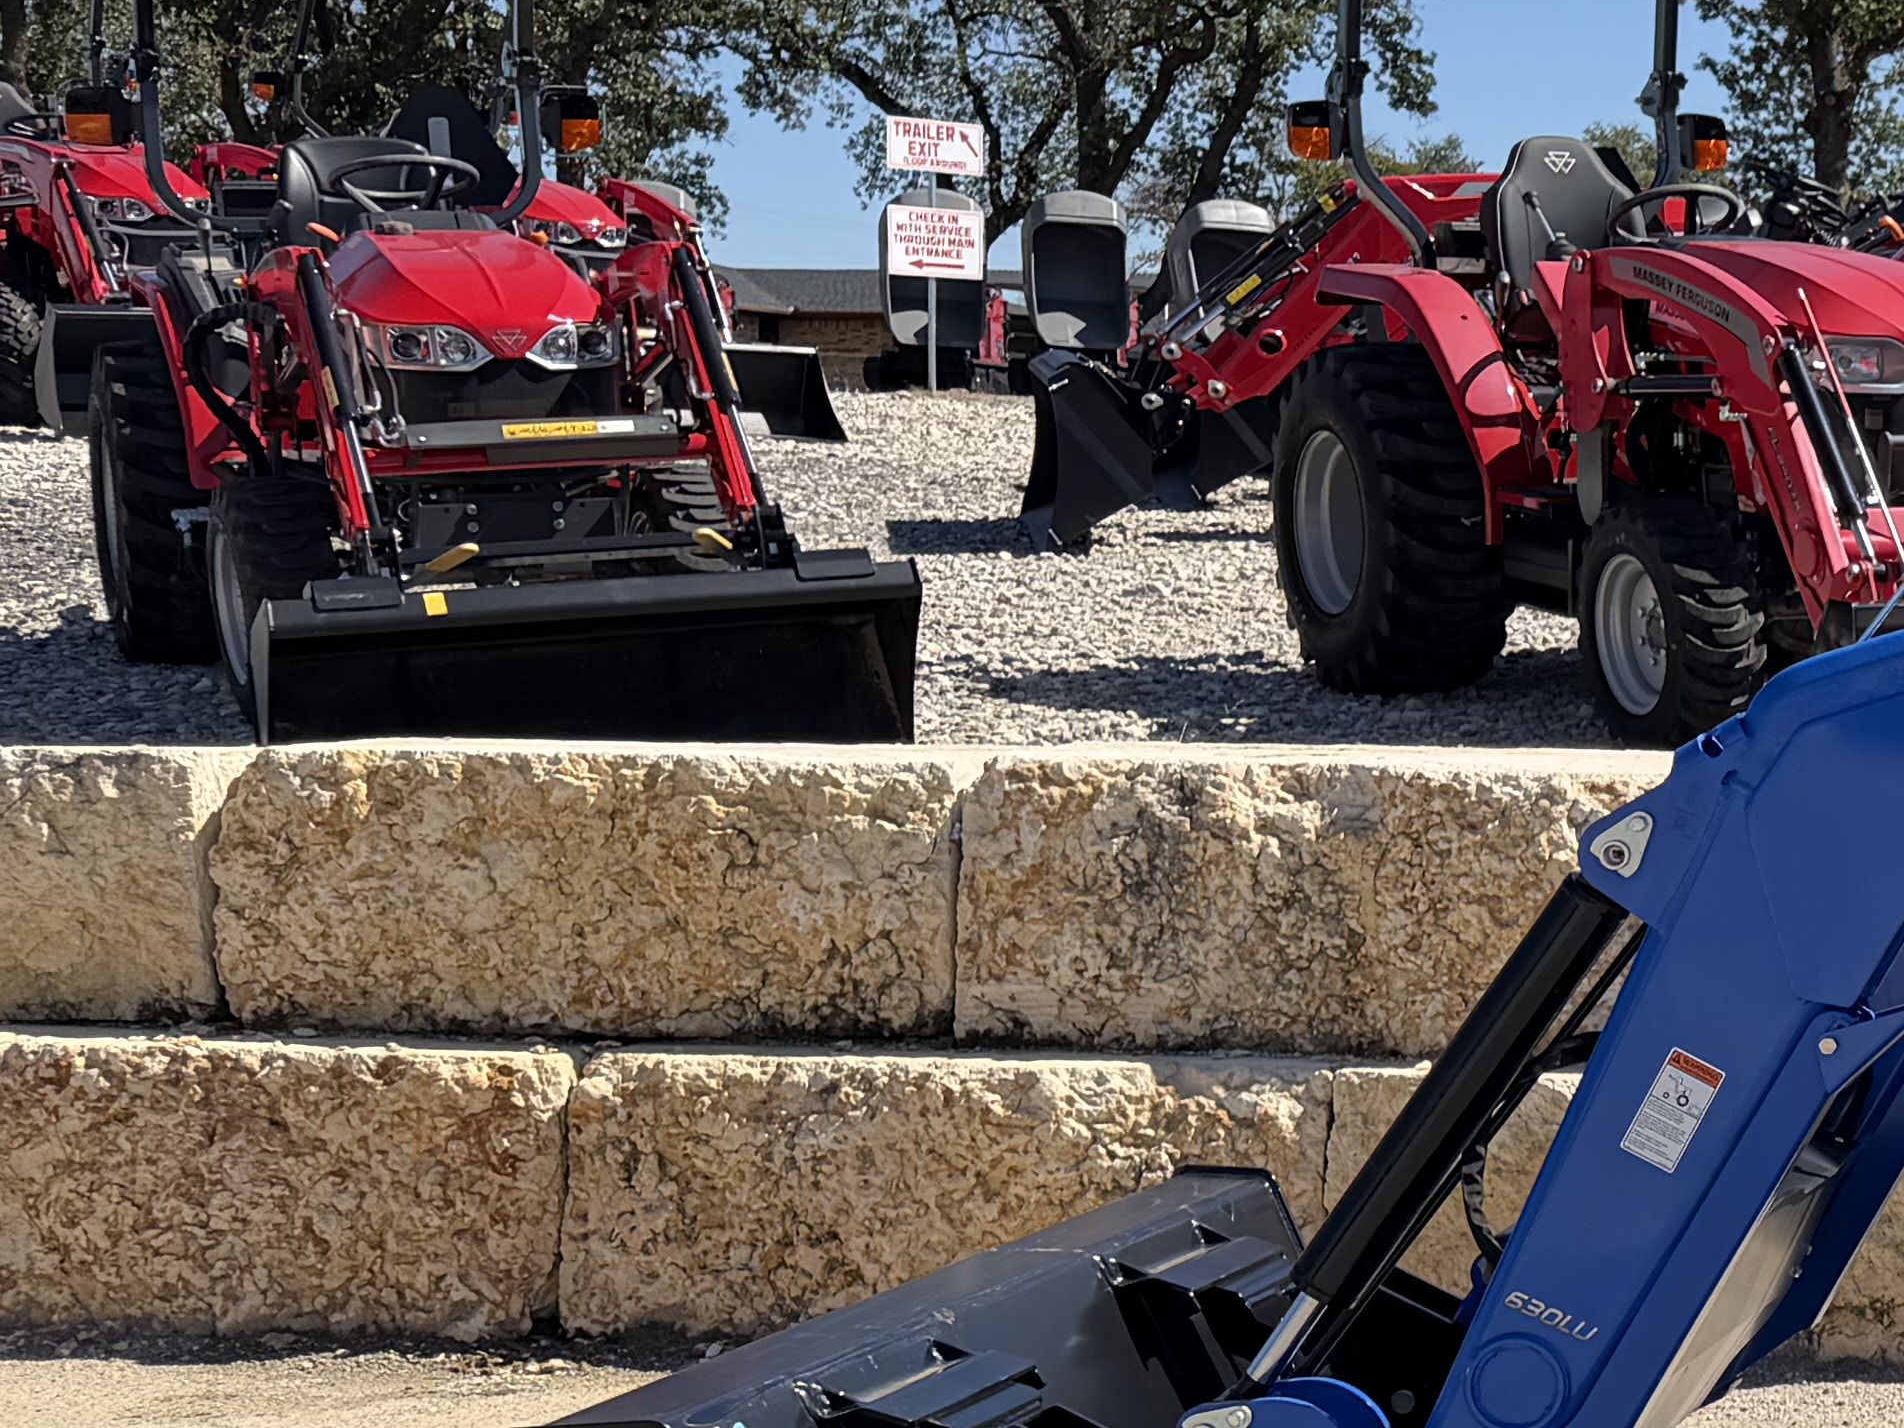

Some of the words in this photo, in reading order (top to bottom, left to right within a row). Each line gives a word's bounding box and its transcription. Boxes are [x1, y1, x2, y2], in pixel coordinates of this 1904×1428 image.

[893, 121, 955, 142] TRAILER
[908, 141, 940, 157] EXIT
[909, 211, 945, 224] CHECK
[948, 215, 959, 225] IN
[896, 222, 922, 233] WITH
[924, 226, 972, 238] SERVICE
[894, 233, 945, 247] THROUGH
[948, 238, 975, 249] MAIN
[905, 246, 963, 260] ENTRANCE
[1633, 265, 1674, 293] MASSEY
[1675, 284, 1730, 323] FERGUSON
[1504, 1291, 1598, 1341] 630LU
